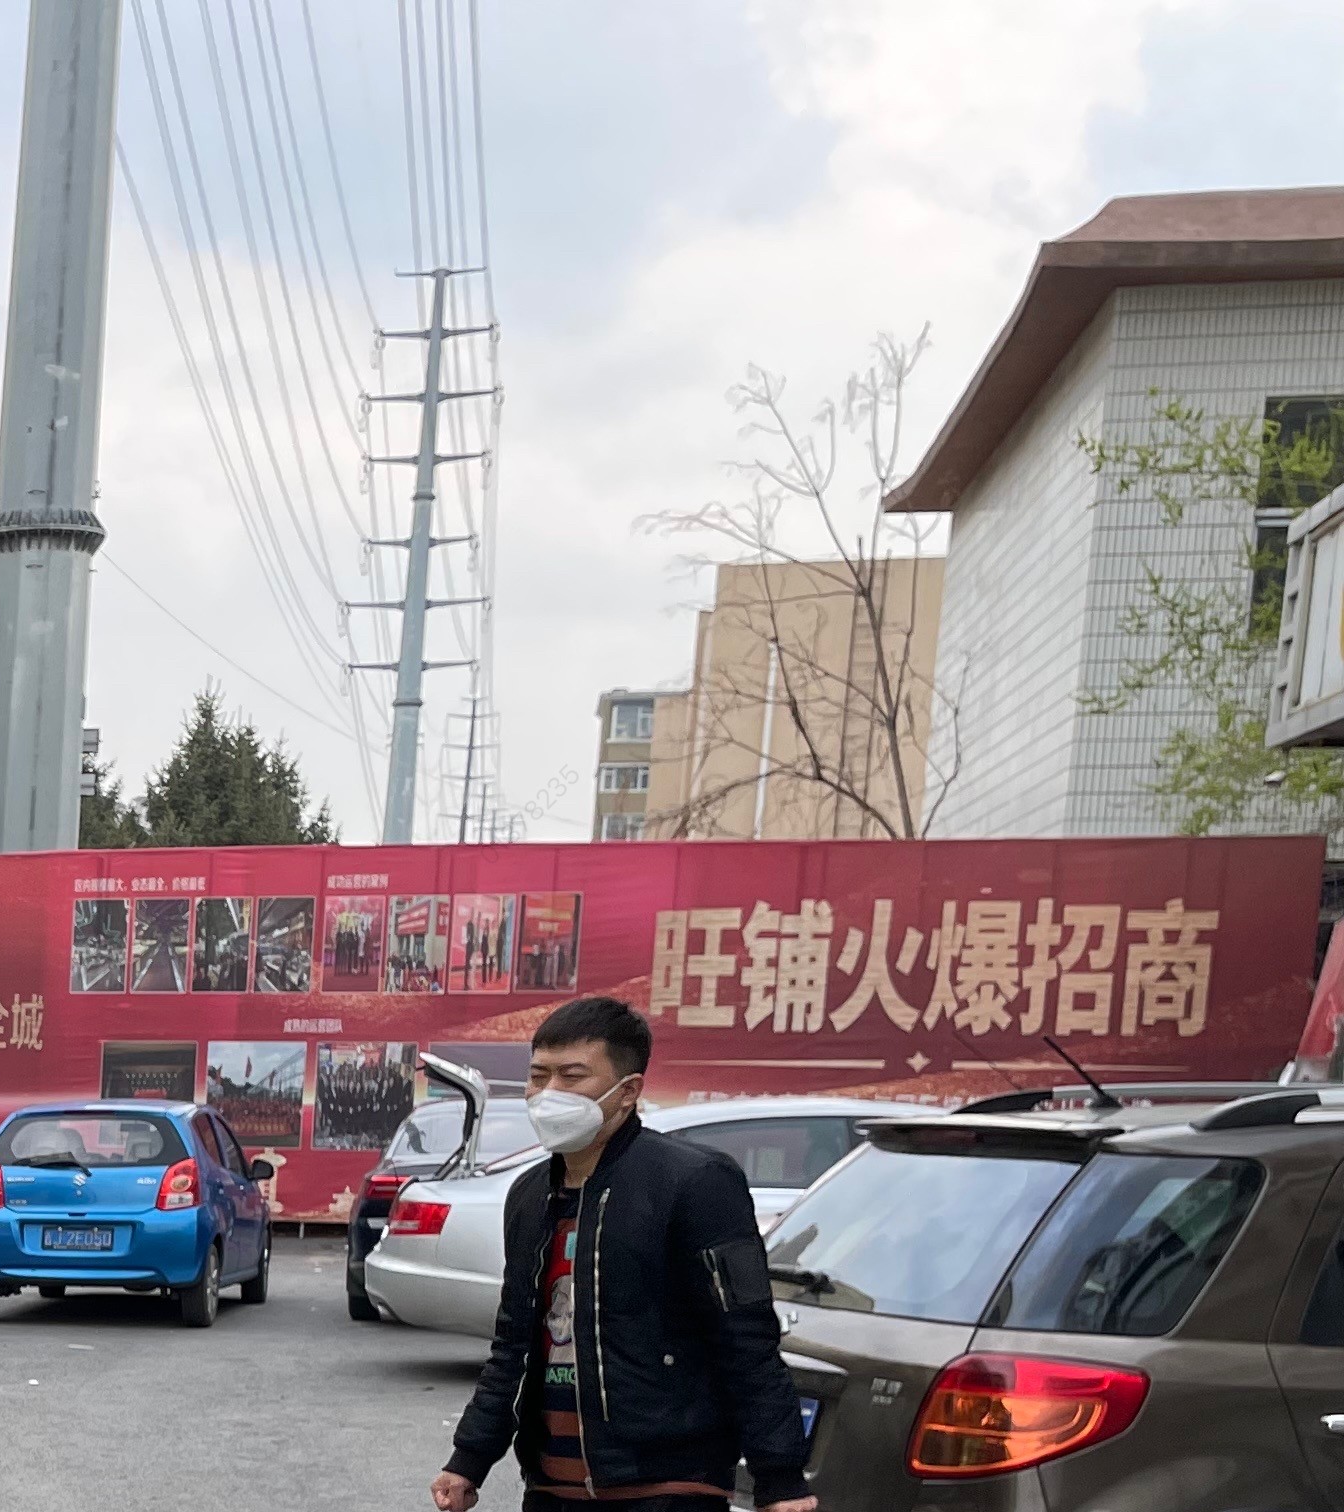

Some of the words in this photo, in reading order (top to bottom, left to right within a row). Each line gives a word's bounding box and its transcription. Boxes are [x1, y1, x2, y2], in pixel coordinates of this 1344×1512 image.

[649, 897, 1220, 1038] 旺铺火爆招商
